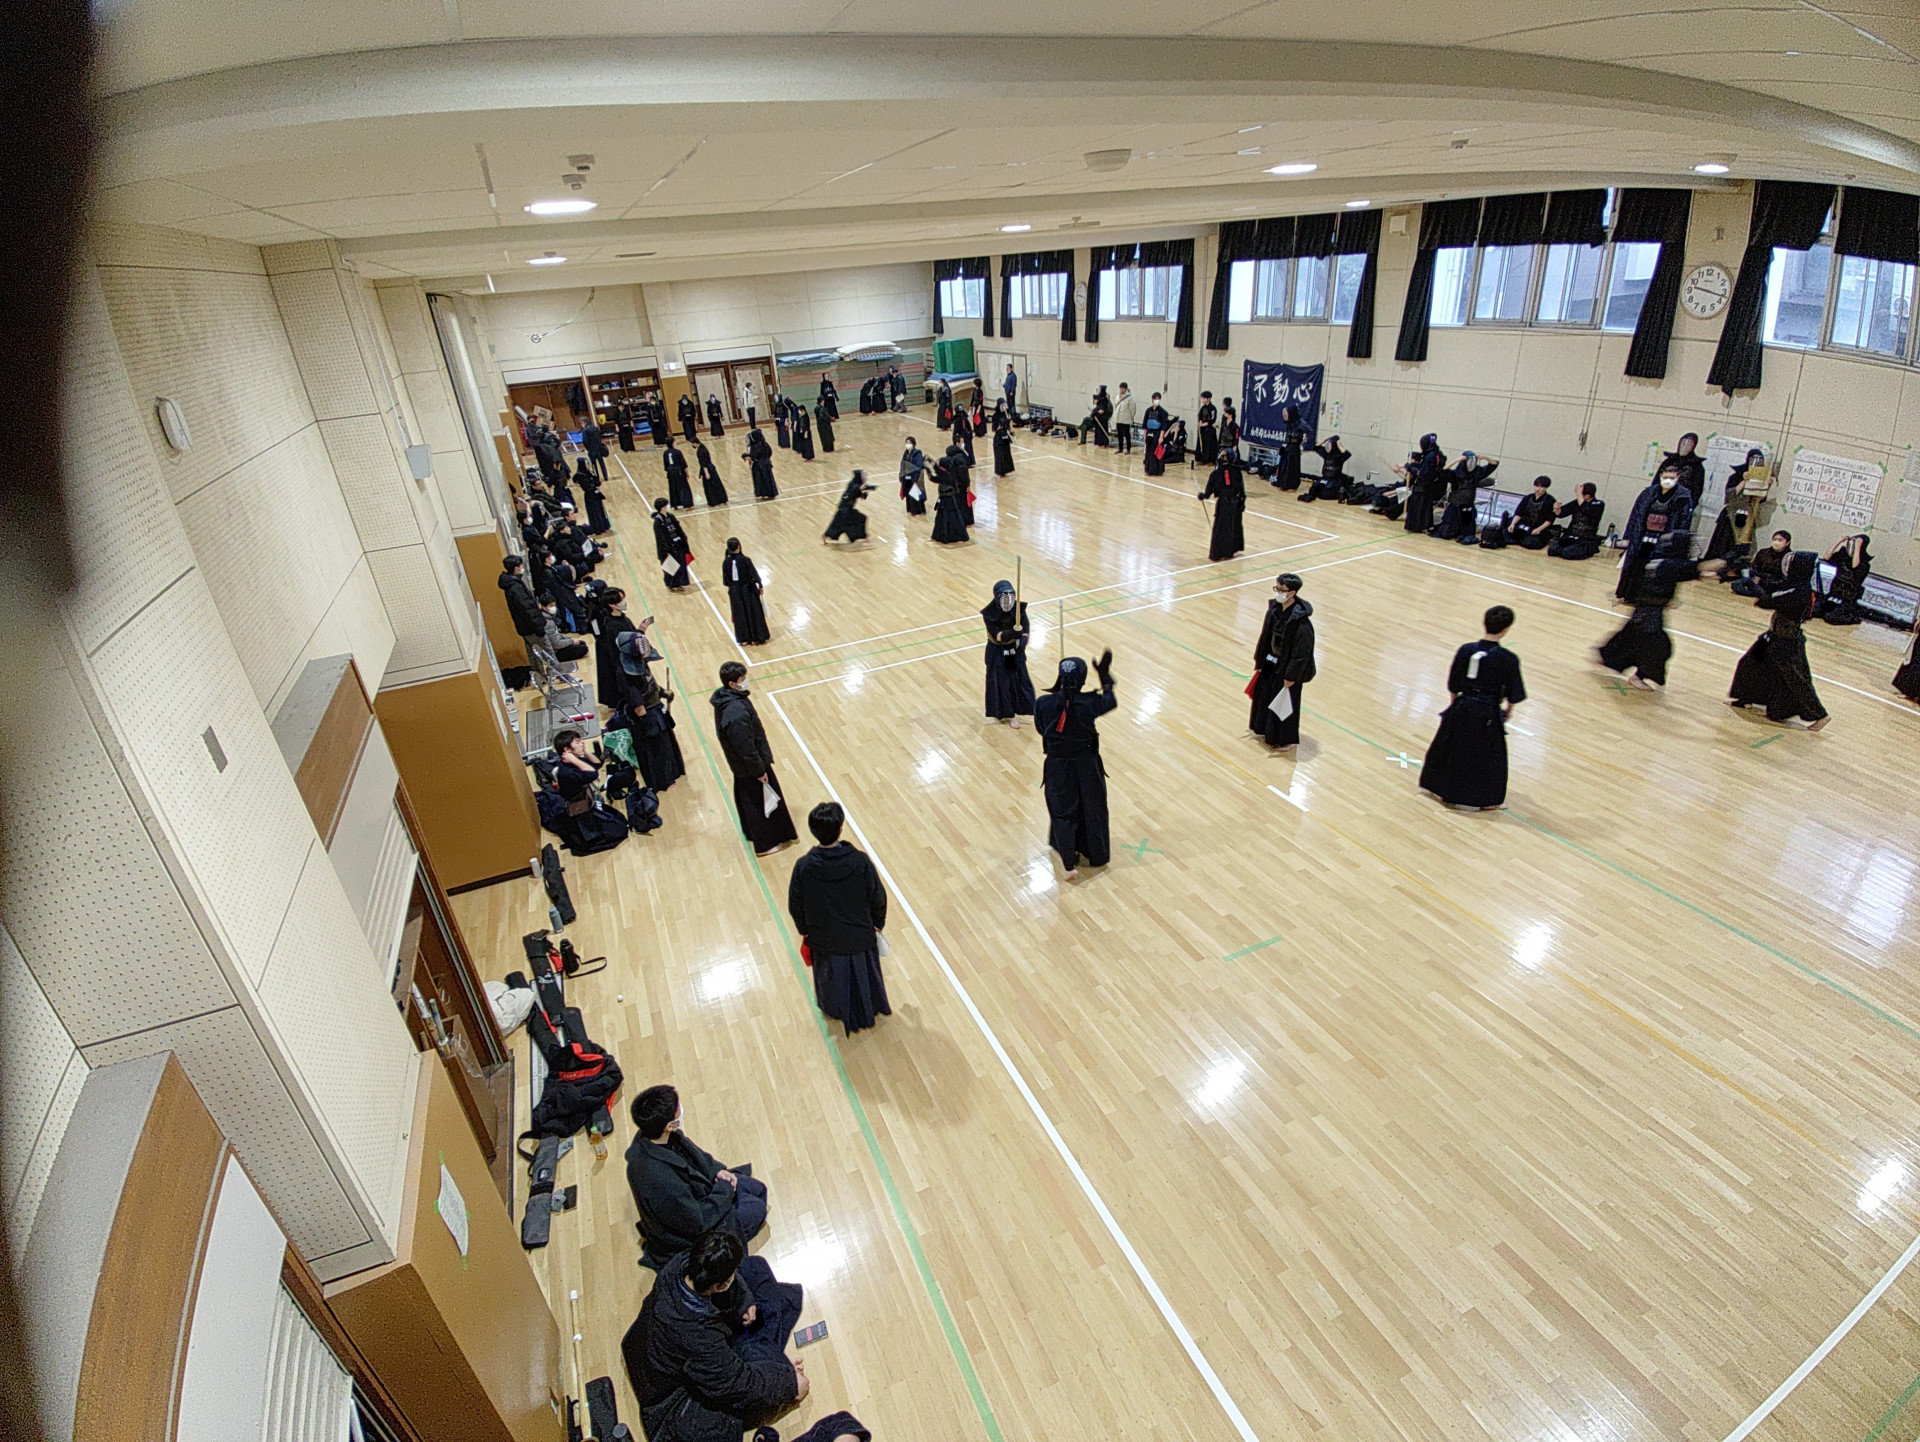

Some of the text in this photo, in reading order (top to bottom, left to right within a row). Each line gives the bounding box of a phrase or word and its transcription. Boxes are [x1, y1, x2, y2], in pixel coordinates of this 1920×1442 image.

[1698, 270, 1704, 278] 11
[1253, 372, 1314, 407] 不動心
[1847, 491, 1874, 508] 自主性
